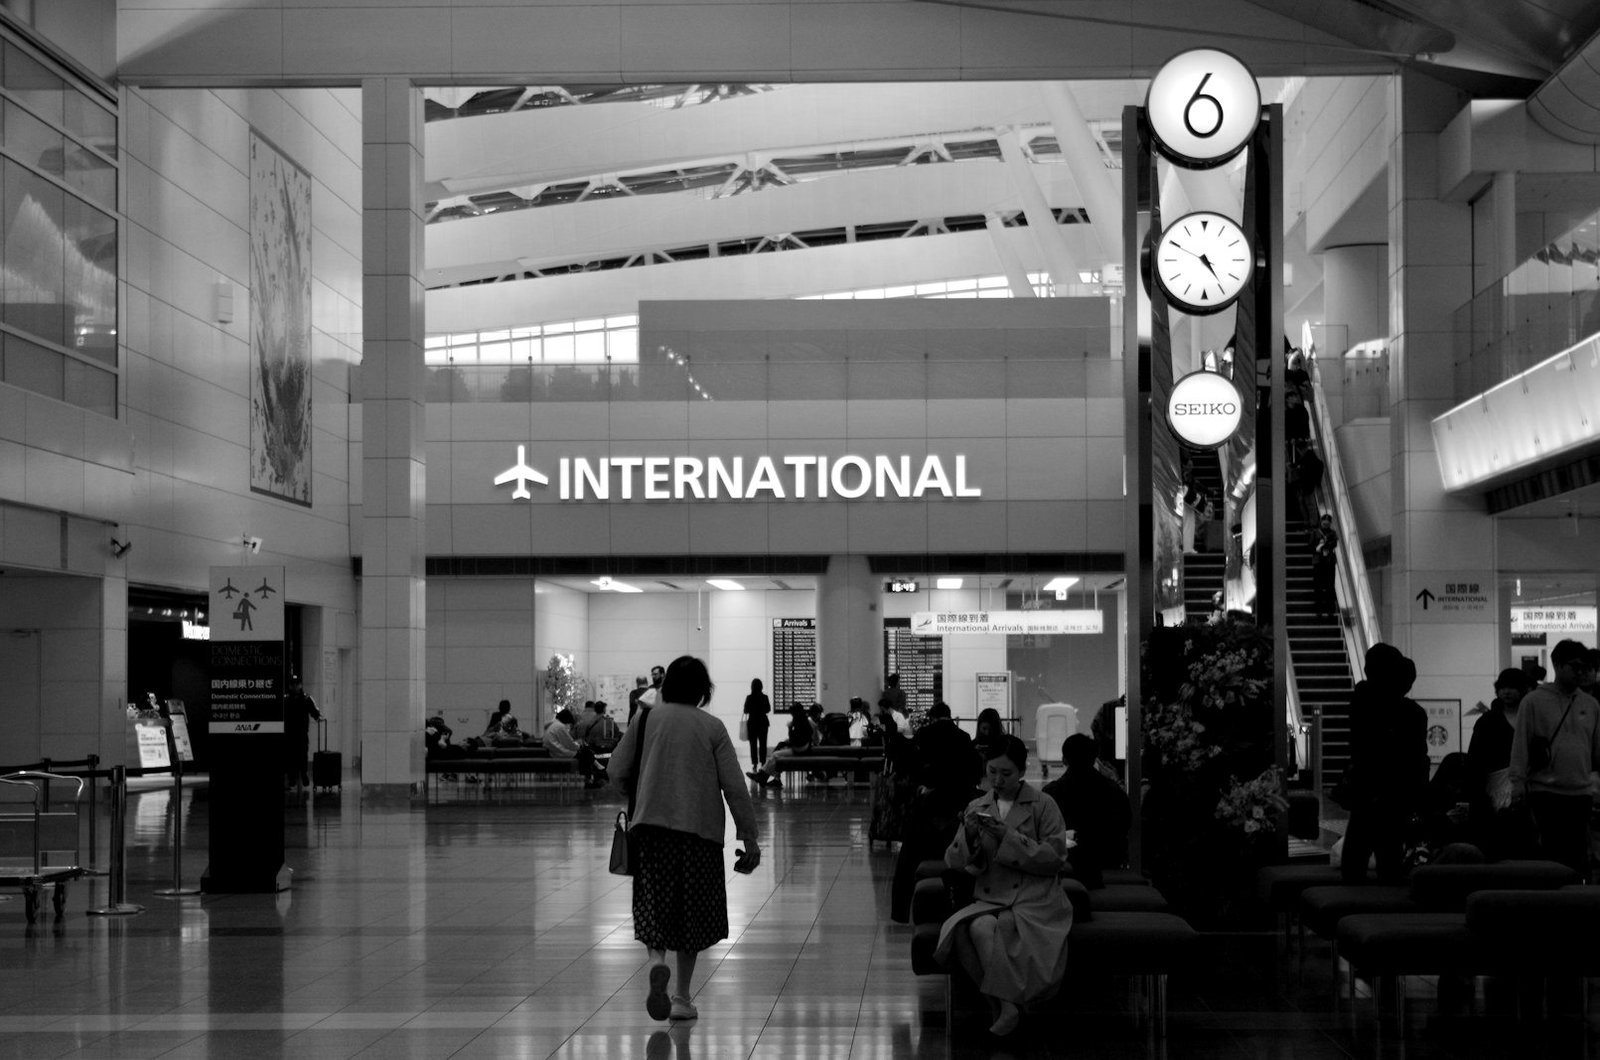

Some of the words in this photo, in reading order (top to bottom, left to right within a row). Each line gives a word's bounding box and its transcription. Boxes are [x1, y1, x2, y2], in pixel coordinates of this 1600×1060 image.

[1183, 72, 1224, 139] 6
[1174, 402, 1236, 416] SEIKO
[559, 455, 981, 501] INTERNATIONAL
[892, 583, 916, 592] 16:49
[937, 624, 990, 632] International
[992, 624, 1023, 632] Arrivals
[1523, 622, 1567, 630] International
[1569, 622, 1595, 630] Arrivals
[211, 645, 264, 656] DOMESTIC
[211, 656, 282, 666] CONNECTIONS
[235, 723, 253, 731] ANA
